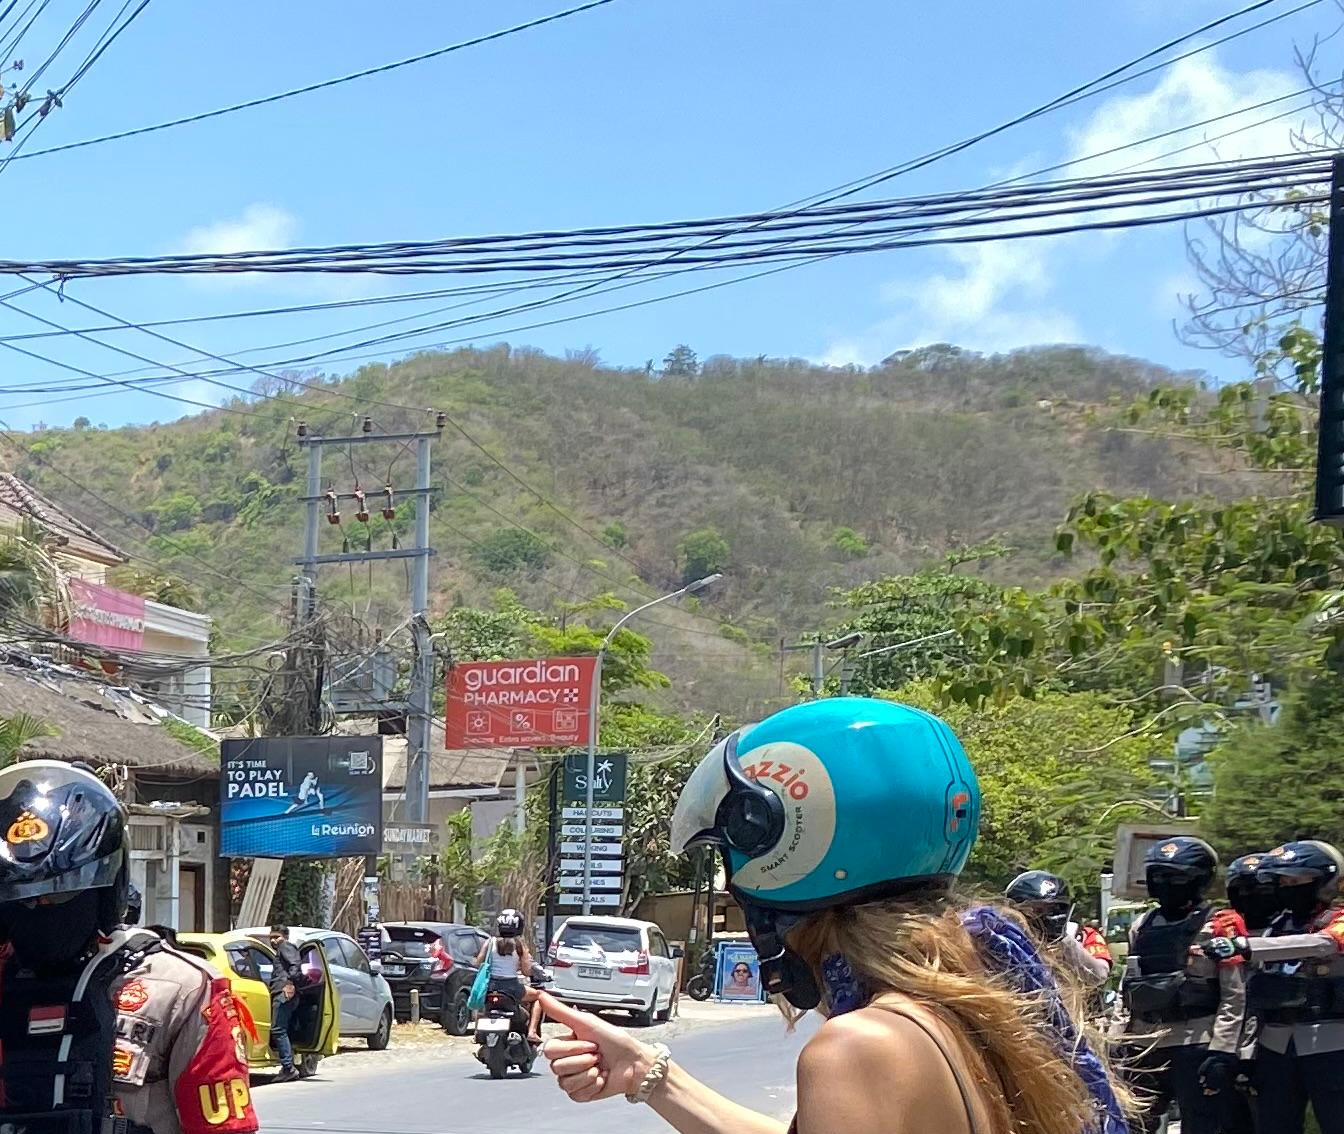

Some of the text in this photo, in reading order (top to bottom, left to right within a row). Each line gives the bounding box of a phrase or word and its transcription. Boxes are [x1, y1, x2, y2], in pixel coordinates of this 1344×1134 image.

[464, 661, 579, 691] guardian
[464, 688, 561, 705] PHARMACY
[247, 760, 267, 768] TIME
[227, 770, 283, 781] TO PLAY
[743, 760, 809, 800] azzio
[228, 782, 289, 798] PADEL
[321, 823, 375, 837] Reunion
[789, 806, 802, 852] SCOOTER
[760, 853, 790, 873] SMART
[198, 1078, 250, 1126] UP
